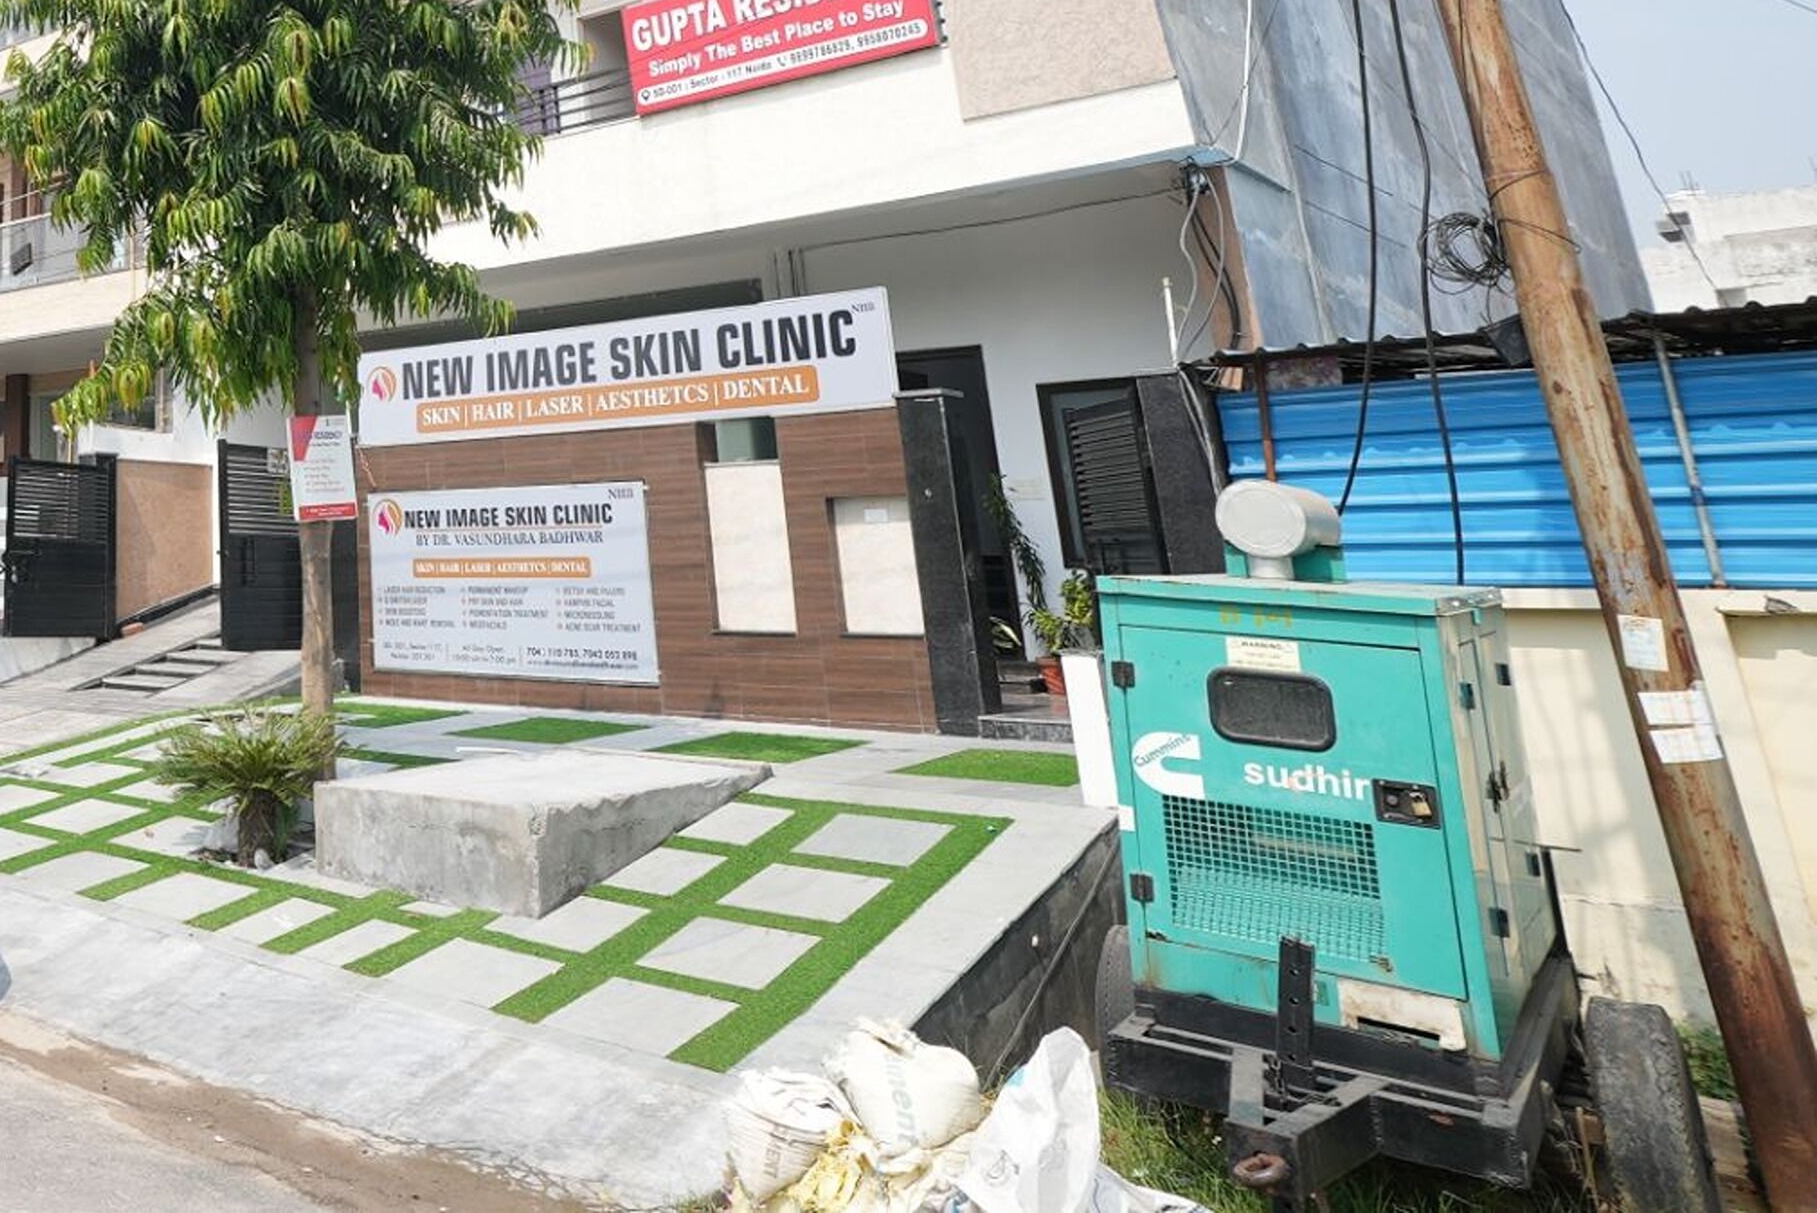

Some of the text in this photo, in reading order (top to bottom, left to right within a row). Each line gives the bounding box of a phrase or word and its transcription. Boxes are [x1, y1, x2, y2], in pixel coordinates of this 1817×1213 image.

[648, 0, 904, 77] Simply The Best Place to Stay
[402, 309, 857, 400] NEW IMAGE SKIN CLINIC
[422, 405, 461, 426] SKIN
[471, 401, 515, 422] HAIR
[526, 395, 584, 417] LASER
[724, 375, 810, 401] DENTAL
[404, 503, 613, 528] NEW IMAGE SKIN CLINIC
[416, 535, 429, 546] BY
[540, 530, 604, 544] BADHWAR
[1134, 735, 1191, 768] Cummins
[1244, 761, 1371, 801] sudhir
